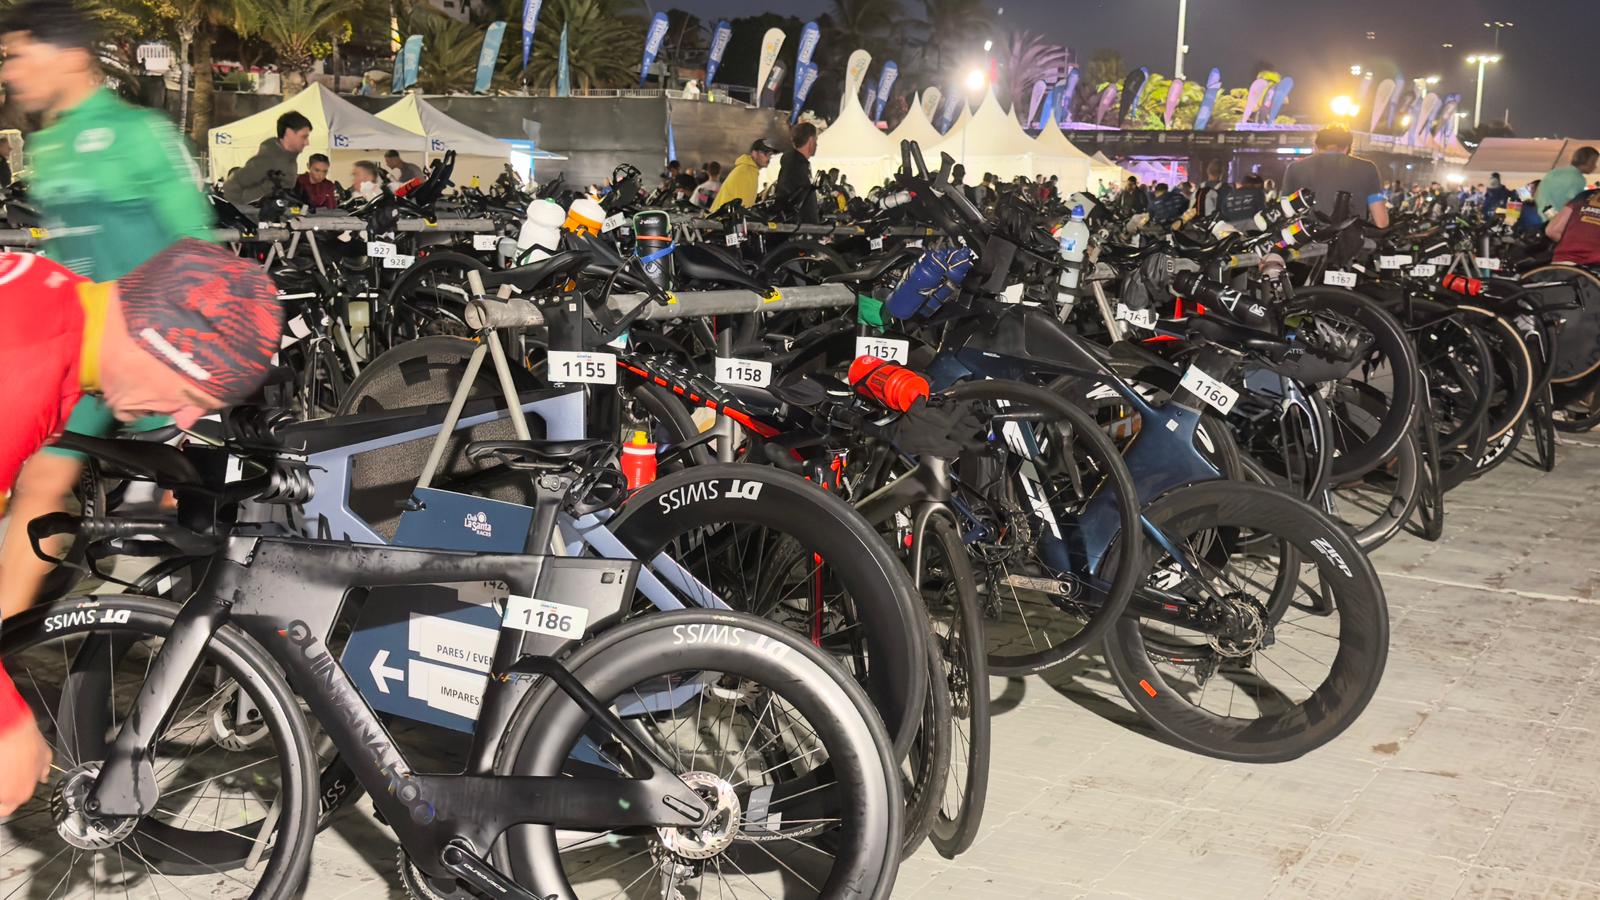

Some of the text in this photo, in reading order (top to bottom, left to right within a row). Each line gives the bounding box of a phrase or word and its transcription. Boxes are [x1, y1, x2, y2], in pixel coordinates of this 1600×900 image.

[373, 246, 390, 255] 927
[390, 258, 406, 266] 928
[1331, 274, 1351, 284] 1167
[864, 344, 898, 359] 1157
[562, 361, 606, 378] 1155
[725, 366, 762, 382] 1158
[1195, 380, 1228, 407] 1160
[658, 479, 763, 514] DT SWISS
[1314, 537, 1353, 577] ZIPP
[44, 608, 132, 632] DT SWISS
[522, 608, 573, 632] 1186
[436, 643, 465, 660] PARES
[672, 623, 791, 659] DT SWISS
[286, 618, 390, 768] QUINTANA
[440, 685, 480, 706] IMPARES
